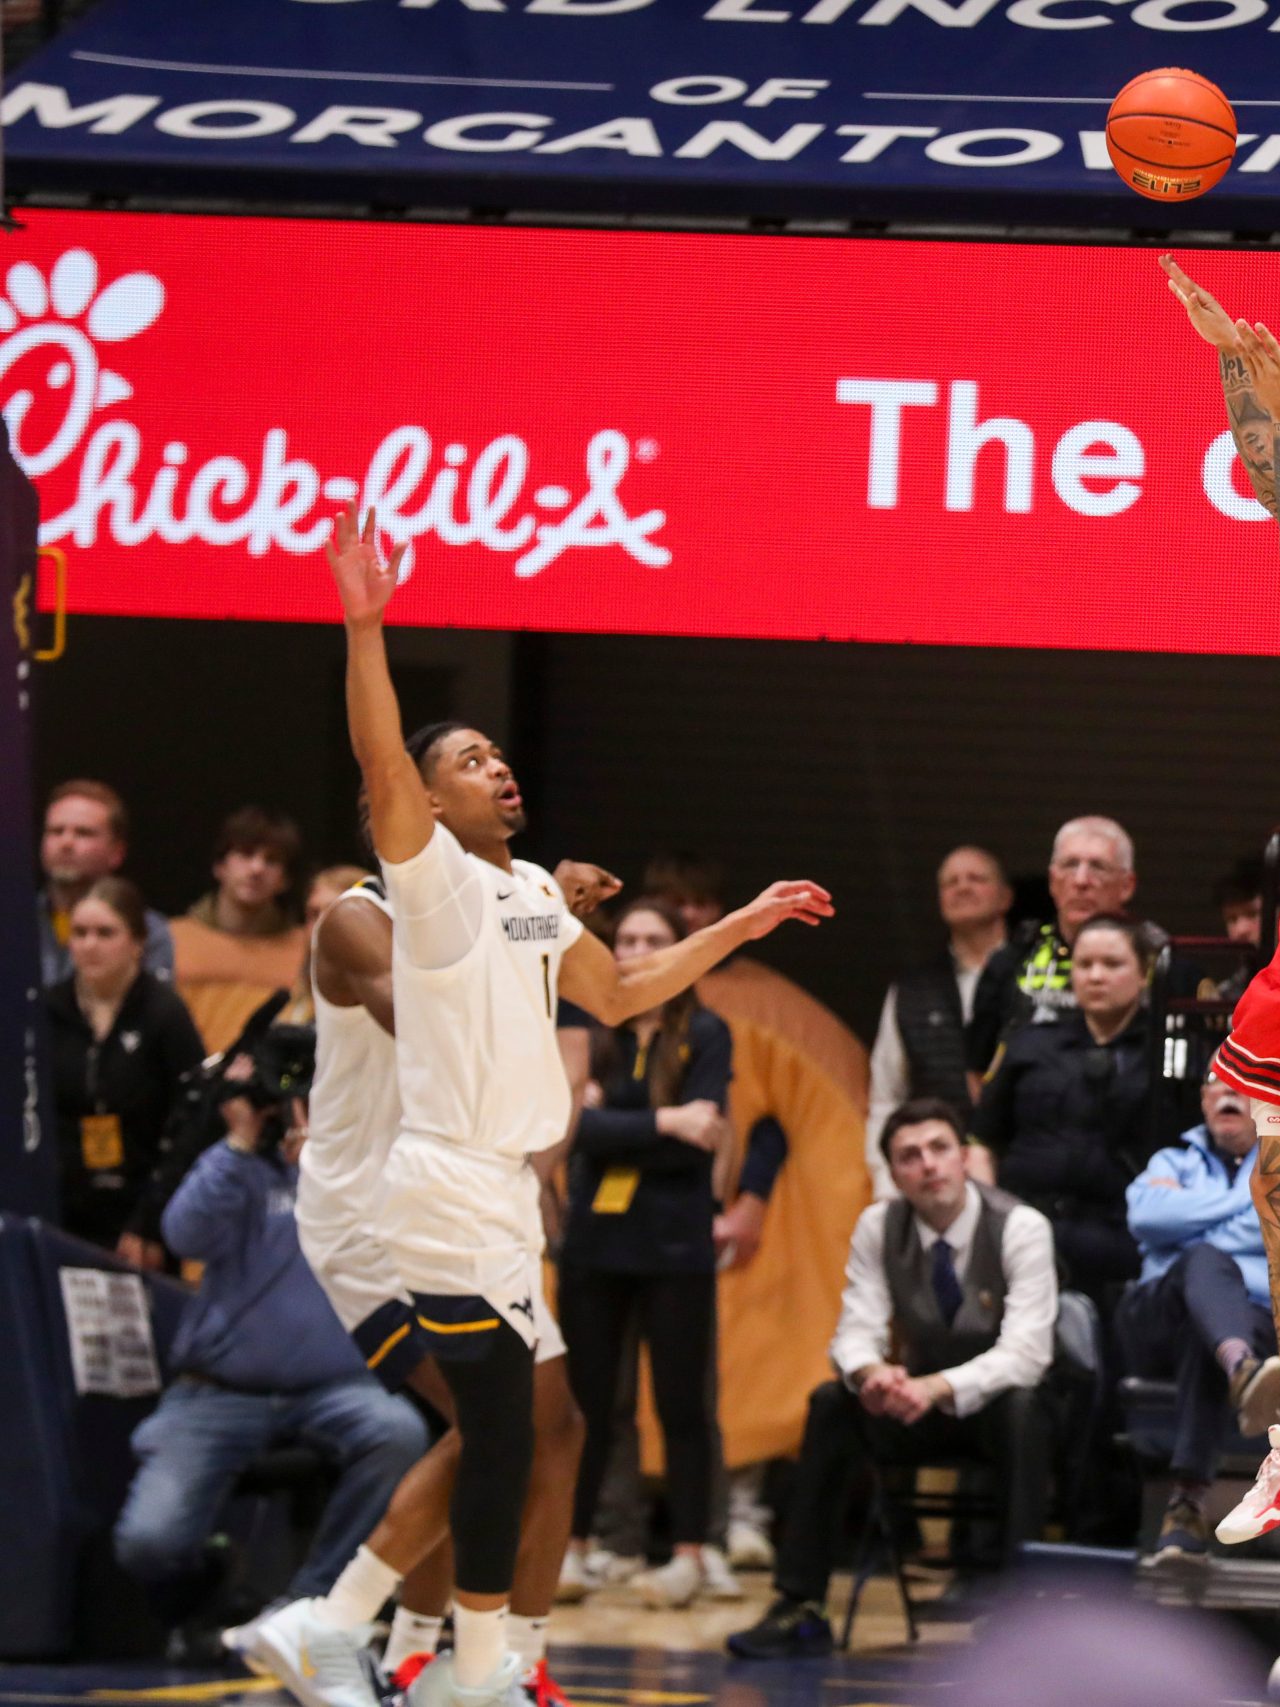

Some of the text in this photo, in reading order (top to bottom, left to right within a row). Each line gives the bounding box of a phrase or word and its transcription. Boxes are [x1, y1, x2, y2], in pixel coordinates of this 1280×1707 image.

[649, 75, 831, 107] OF
[835, 377, 1147, 517] The
[541, 953, 552, 1019] 1
